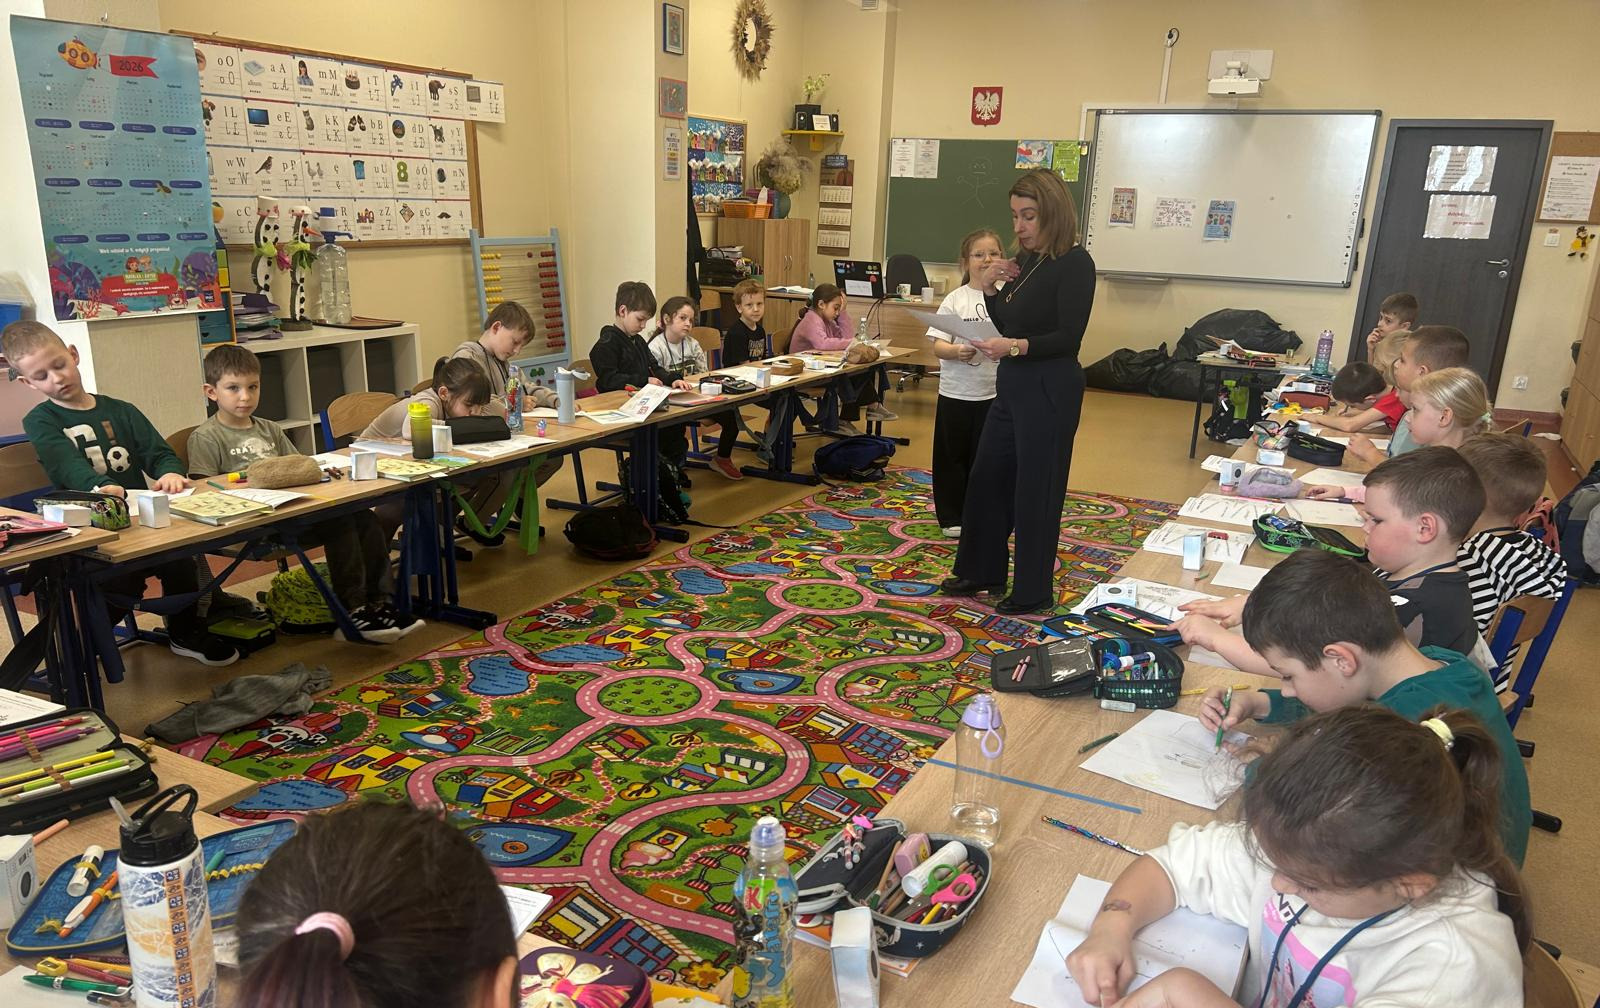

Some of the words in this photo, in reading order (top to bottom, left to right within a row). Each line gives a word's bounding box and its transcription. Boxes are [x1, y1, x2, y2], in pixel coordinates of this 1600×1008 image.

[119, 60, 144, 72] 2026
[226, 56, 234, 67] O
[279, 63, 286, 73] A
[329, 69, 337, 80] M
[285, 112, 291, 123] E
[332, 116, 339, 126] K
[236, 157, 246, 167] W
[660, 889, 692, 905] P
[745, 886, 763, 910] K
